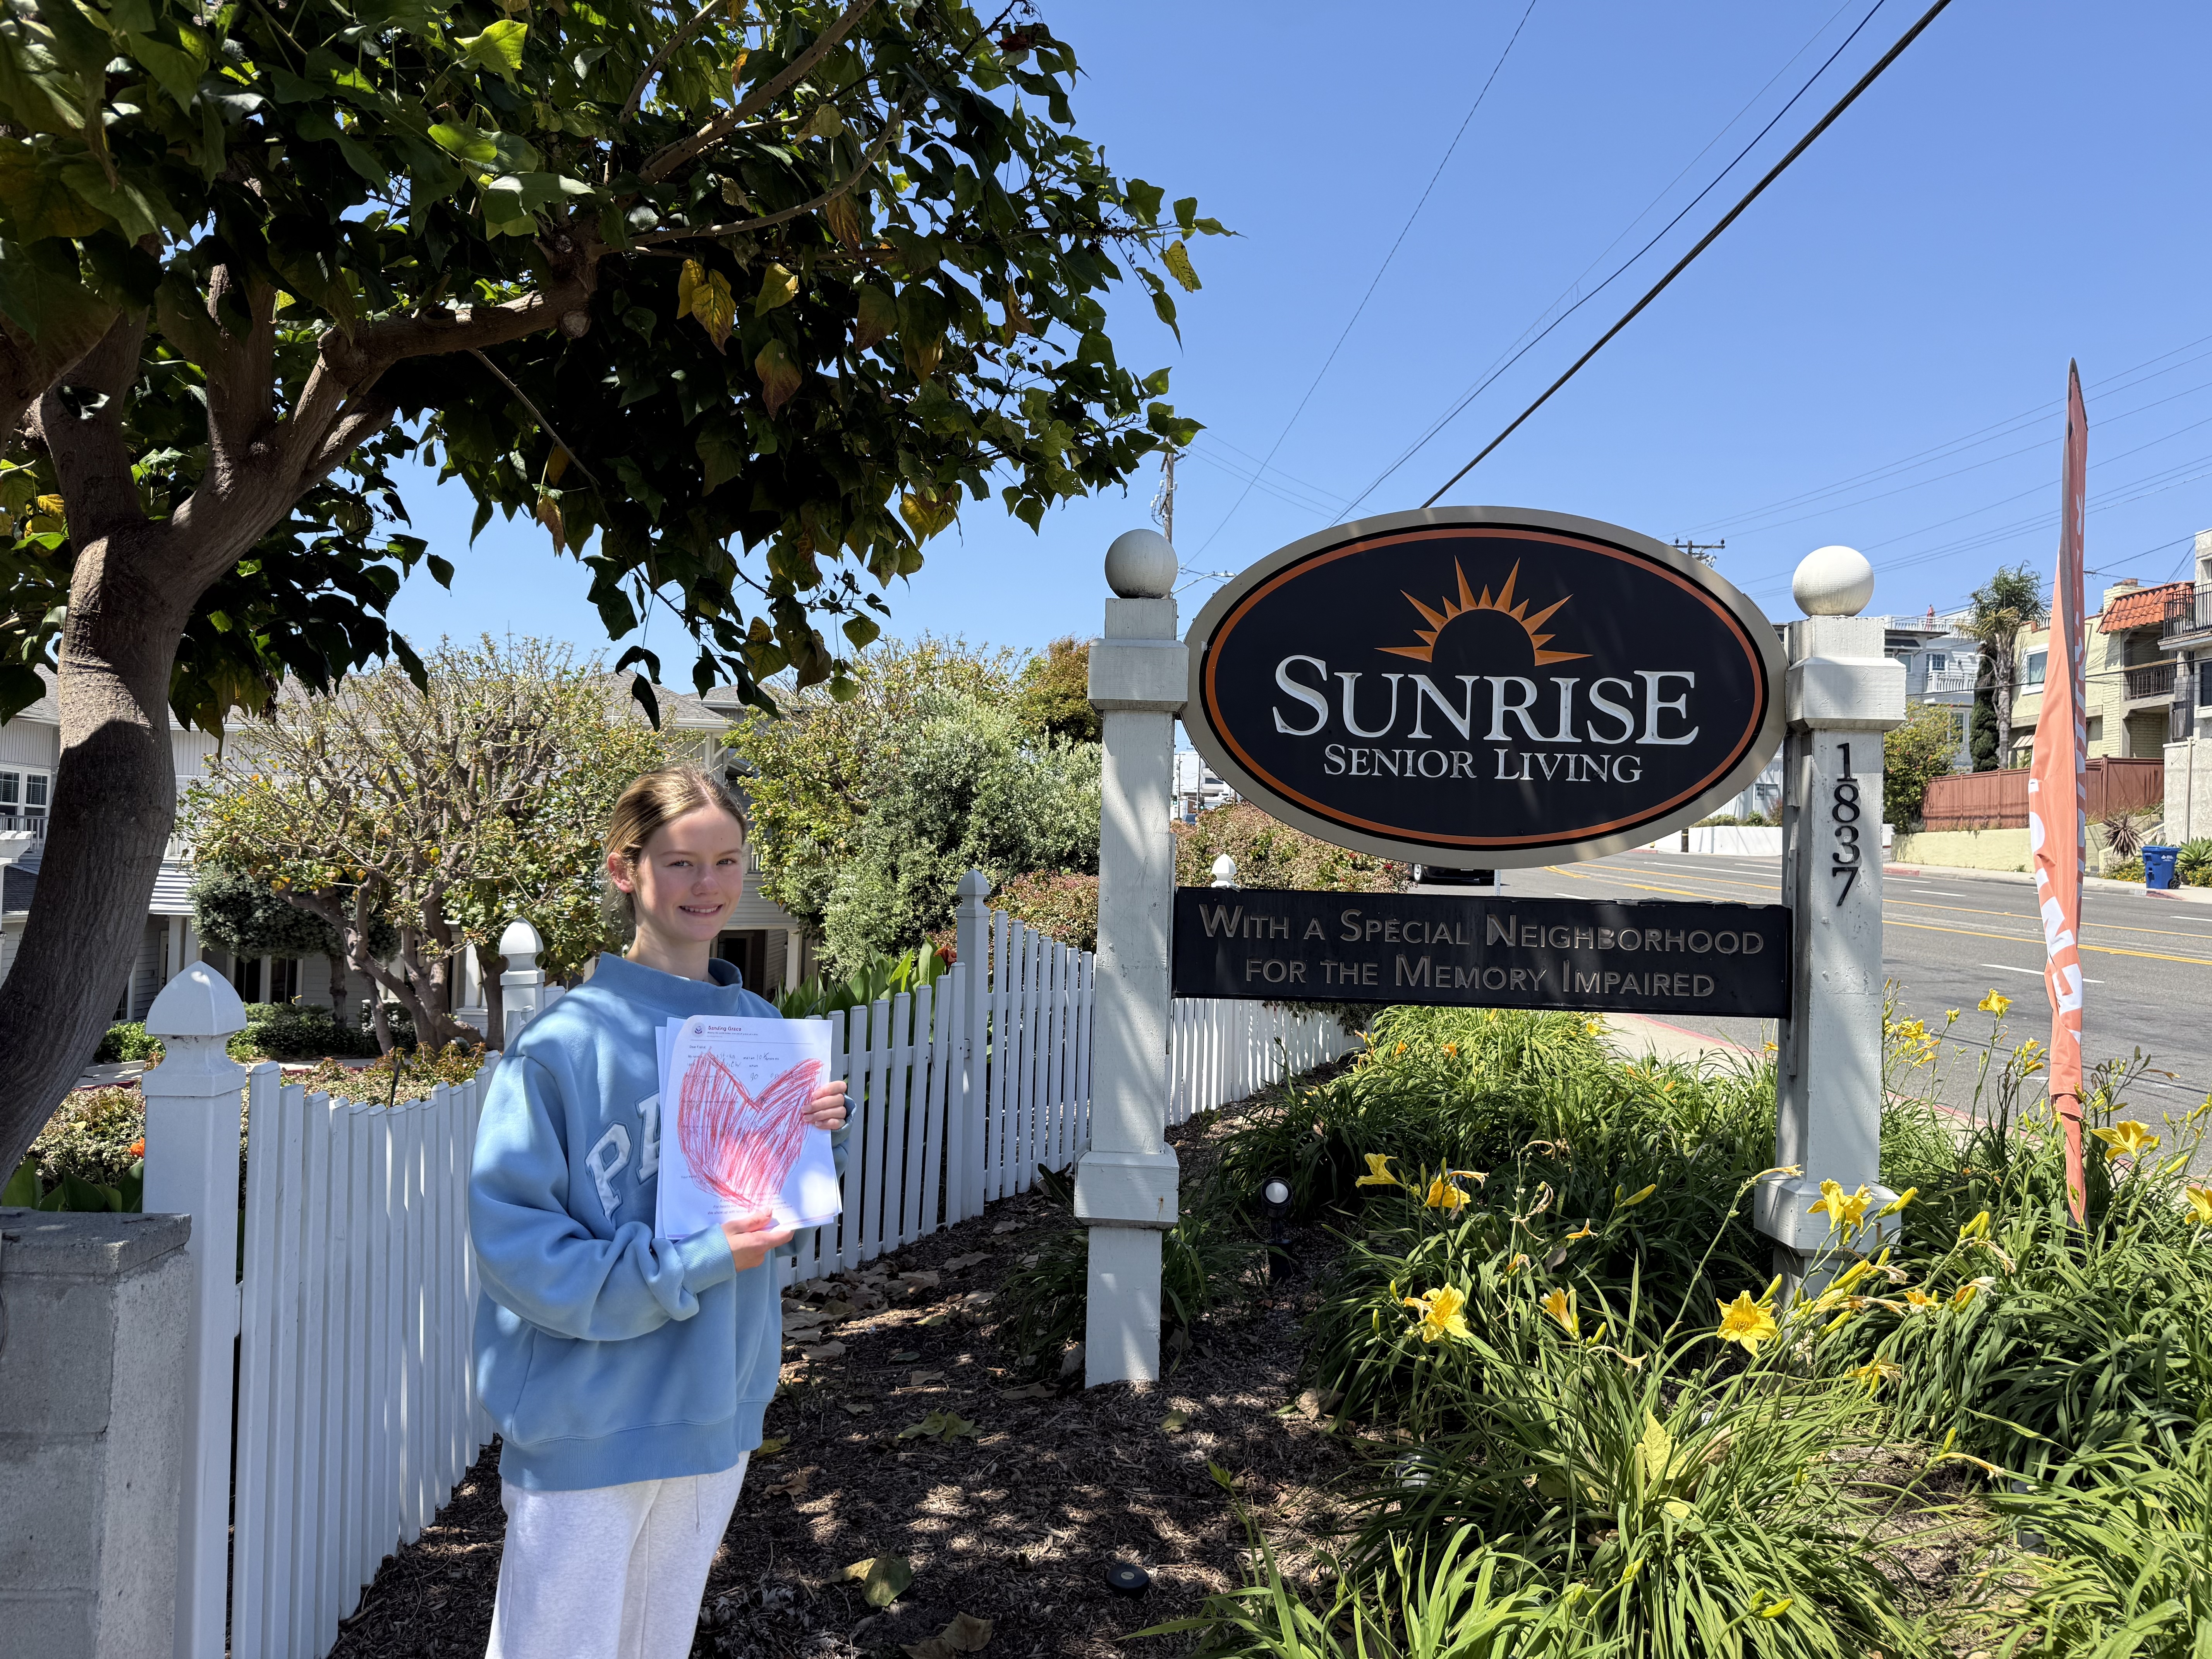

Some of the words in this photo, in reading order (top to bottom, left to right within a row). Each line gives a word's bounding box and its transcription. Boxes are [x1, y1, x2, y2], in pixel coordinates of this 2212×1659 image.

[1273, 654, 1699, 745] SUNRISE
[1324, 744, 1477, 778] SENIOR
[1494, 749, 1643, 783] LIVING
[1832, 742, 1860, 907] 1837
[1199, 904, 1290, 939] WITH
[1304, 917, 1326, 940] A
[1340, 908, 1470, 945] SPECIAL
[1487, 914, 1764, 954] NEIGHBORHOOD
[1246, 958, 1307, 984] FOR
[1320, 960, 1379, 985] THE
[1396, 954, 1547, 991] MEMORY
[1563, 959, 1715, 997] IMPAIRED
